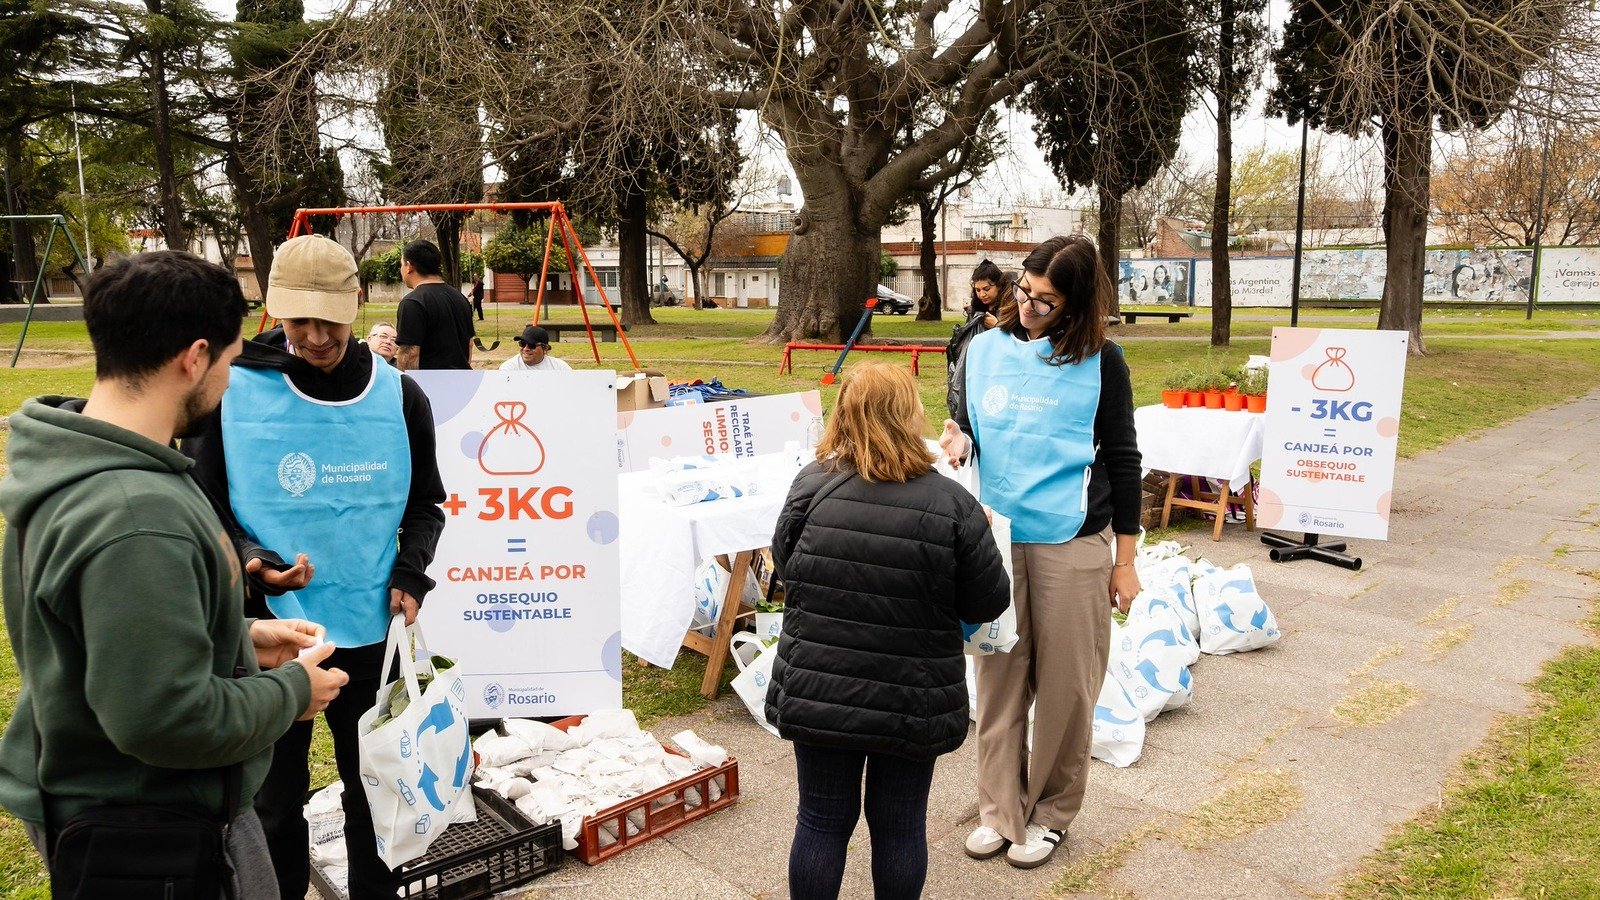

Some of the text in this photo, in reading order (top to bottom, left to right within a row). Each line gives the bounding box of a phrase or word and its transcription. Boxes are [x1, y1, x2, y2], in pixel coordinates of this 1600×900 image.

[1555, 269, 1596, 278] ¡Vamos
[1238, 277, 1280, 287] Argentina
[1009, 402, 1019, 410] de
[1011, 393, 1059, 406] Municipalidad
[1310, 399, 1373, 422] 3KG
[715, 407, 729, 453] LIMPIO
[730, 405, 743, 458] RECICLABL
[742, 412, 753, 438] TRAÉ
[1284, 442, 1373, 457] CANJEÁ POR
[321, 461, 388, 473] Municipalidad
[1297, 459, 1356, 470] OBSEQUIO
[321, 473, 371, 483] de Rosario
[1286, 469, 1365, 482] SUSTENTABLE
[477, 486, 574, 521] 3KG
[1313, 519, 1344, 528] Rosario
[447, 562, 586, 582] CANJEÁ POR
[476, 592, 558, 605] OBSEQUIO
[463, 608, 572, 621] SUSTENTABLE
[508, 692, 556, 704] Rosario
